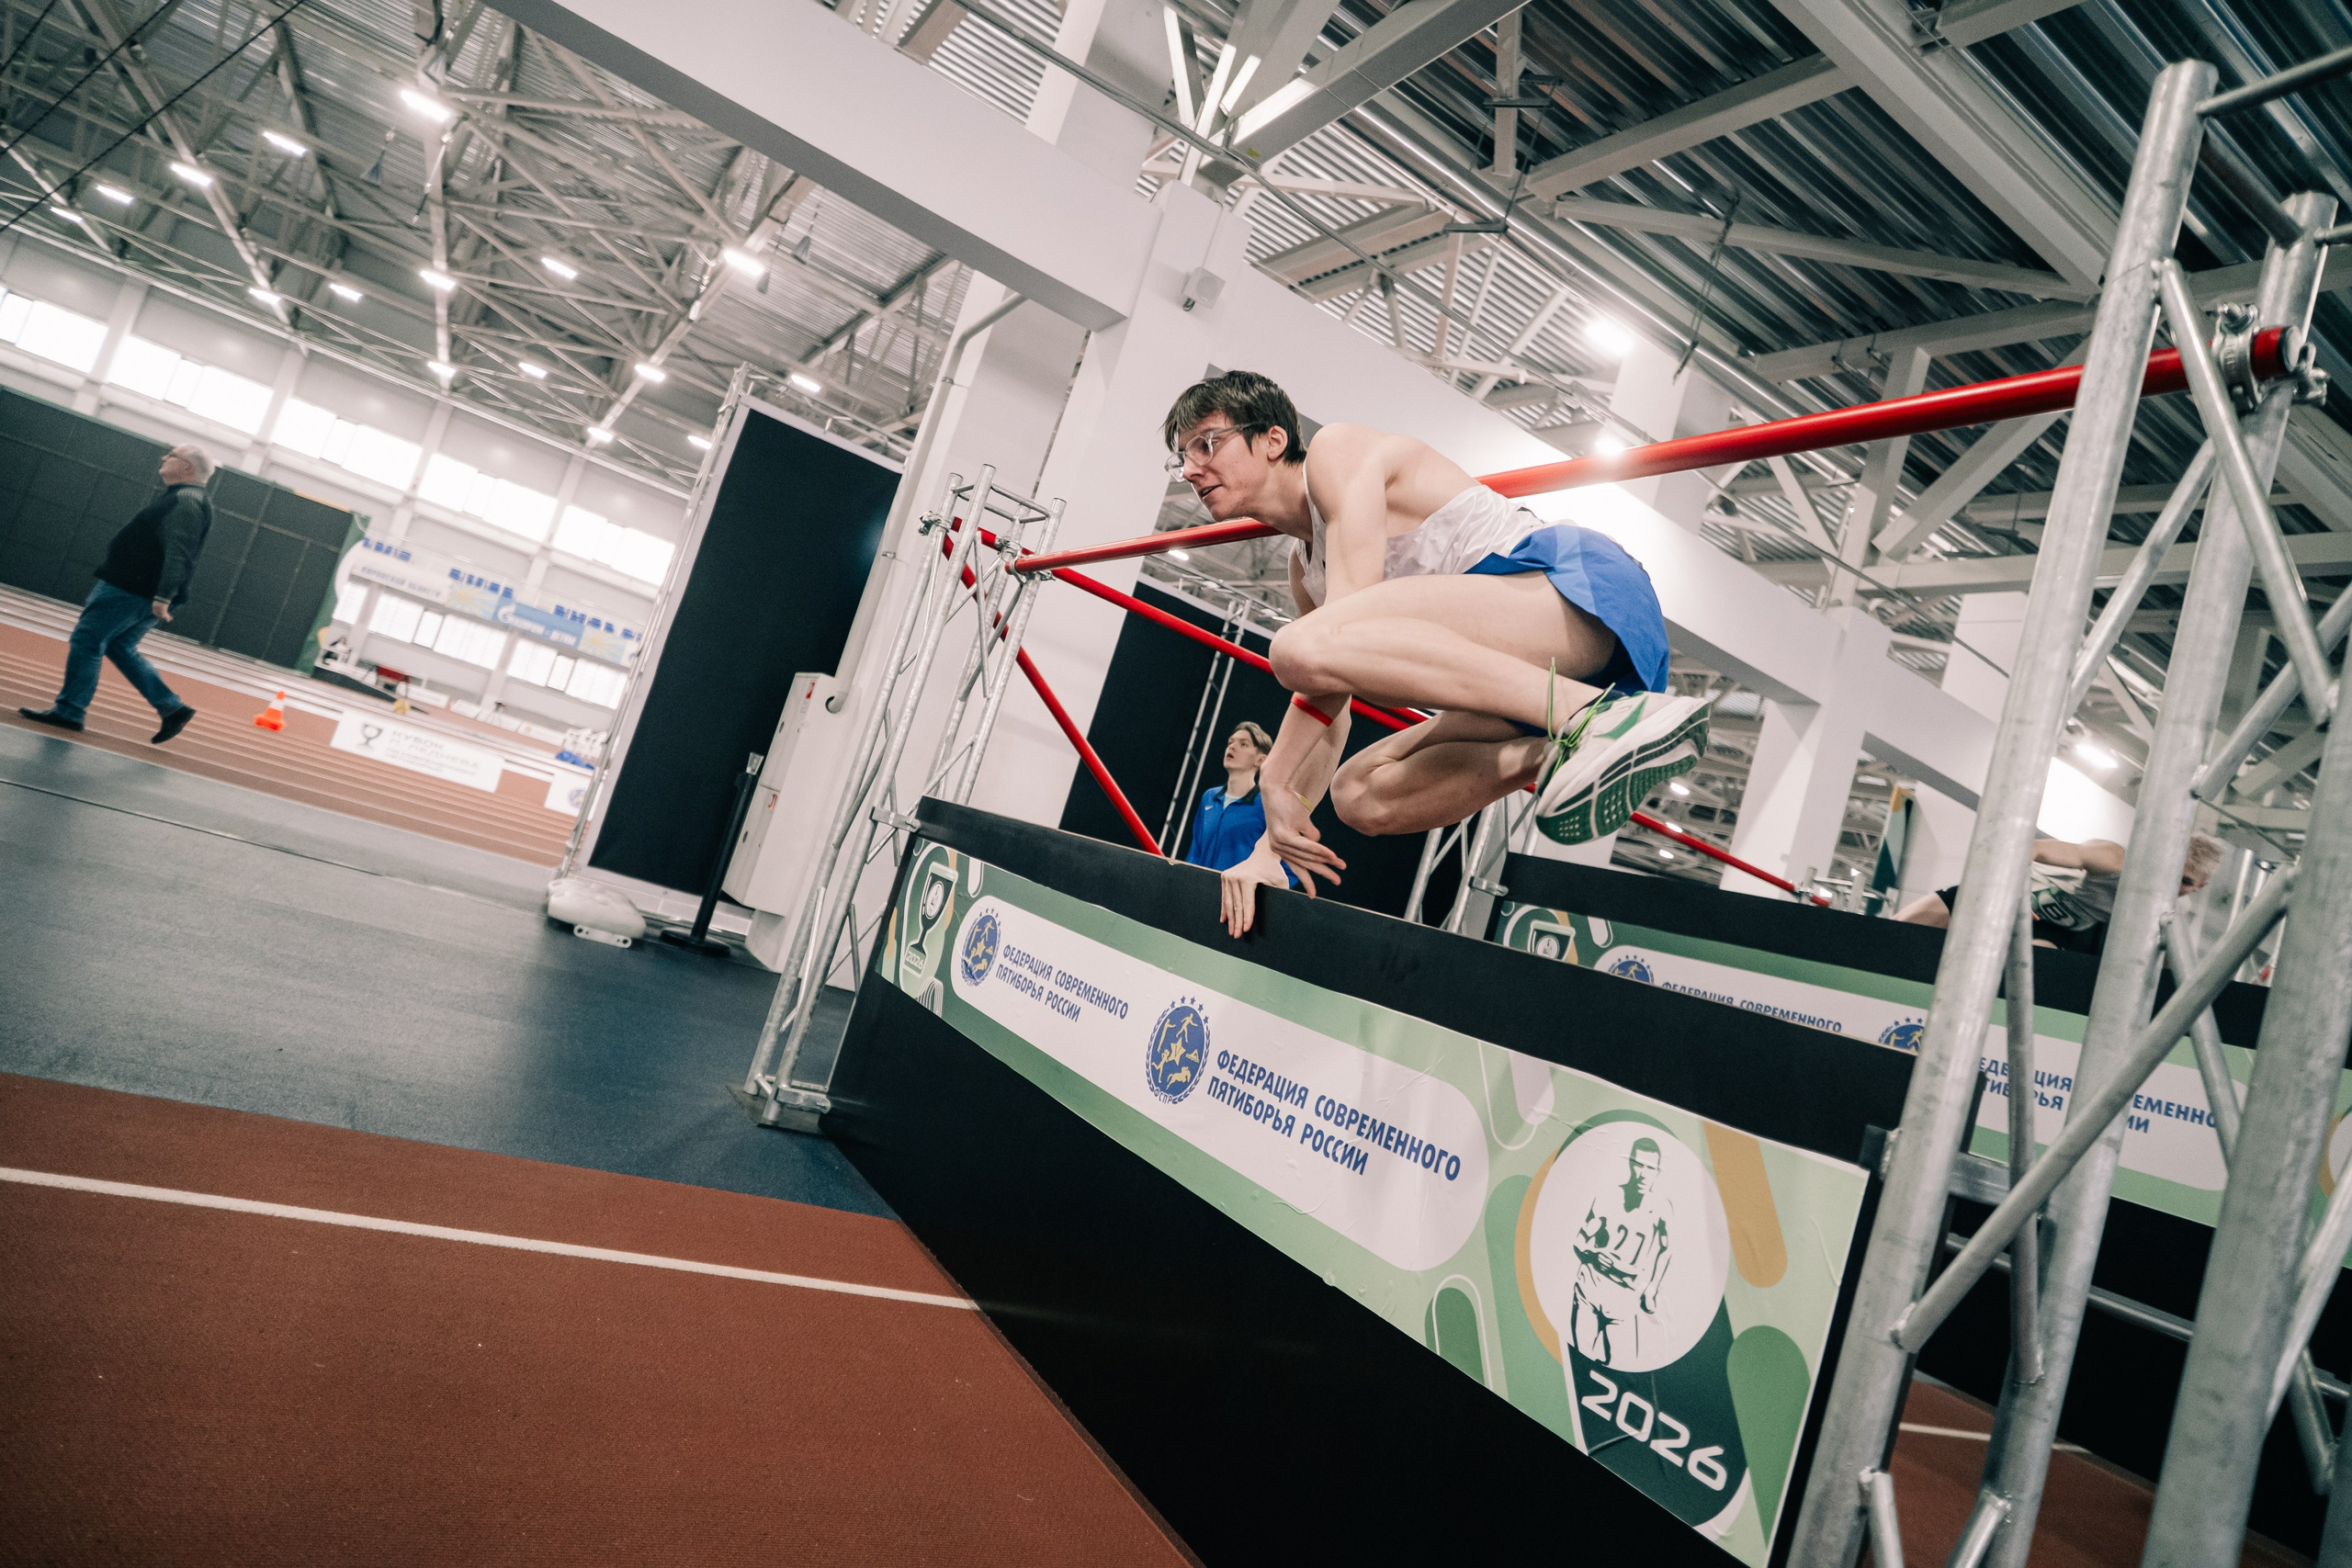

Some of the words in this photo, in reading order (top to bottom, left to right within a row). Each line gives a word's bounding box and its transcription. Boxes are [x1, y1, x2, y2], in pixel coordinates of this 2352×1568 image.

[906, 950, 924, 970] 2026
[996, 964, 1044, 1002] ПЯТИБОРЬЯ
[1045, 990, 1081, 1022] РОССИИ
[1003, 944, 1053, 981] ФЕДЕРАЦИЯ
[1055, 970, 1128, 1020] СОВРЕМЕННОГО
[1207, 1076, 1295, 1137] ПЯТИБОРЬЯ
[1300, 1123, 1369, 1176] РОССИИ
[1217, 1050, 1308, 1109] ФЕДЕРАЦИЯ
[1315, 1095, 1461, 1181] СОВРЕМЕННОГО
[1979, 1057, 2073, 1092] ЕДЕЦИЯ
[2132, 1094, 2217, 1128] ЕМЕННО
[1581, 1370, 1727, 1491] 2026
